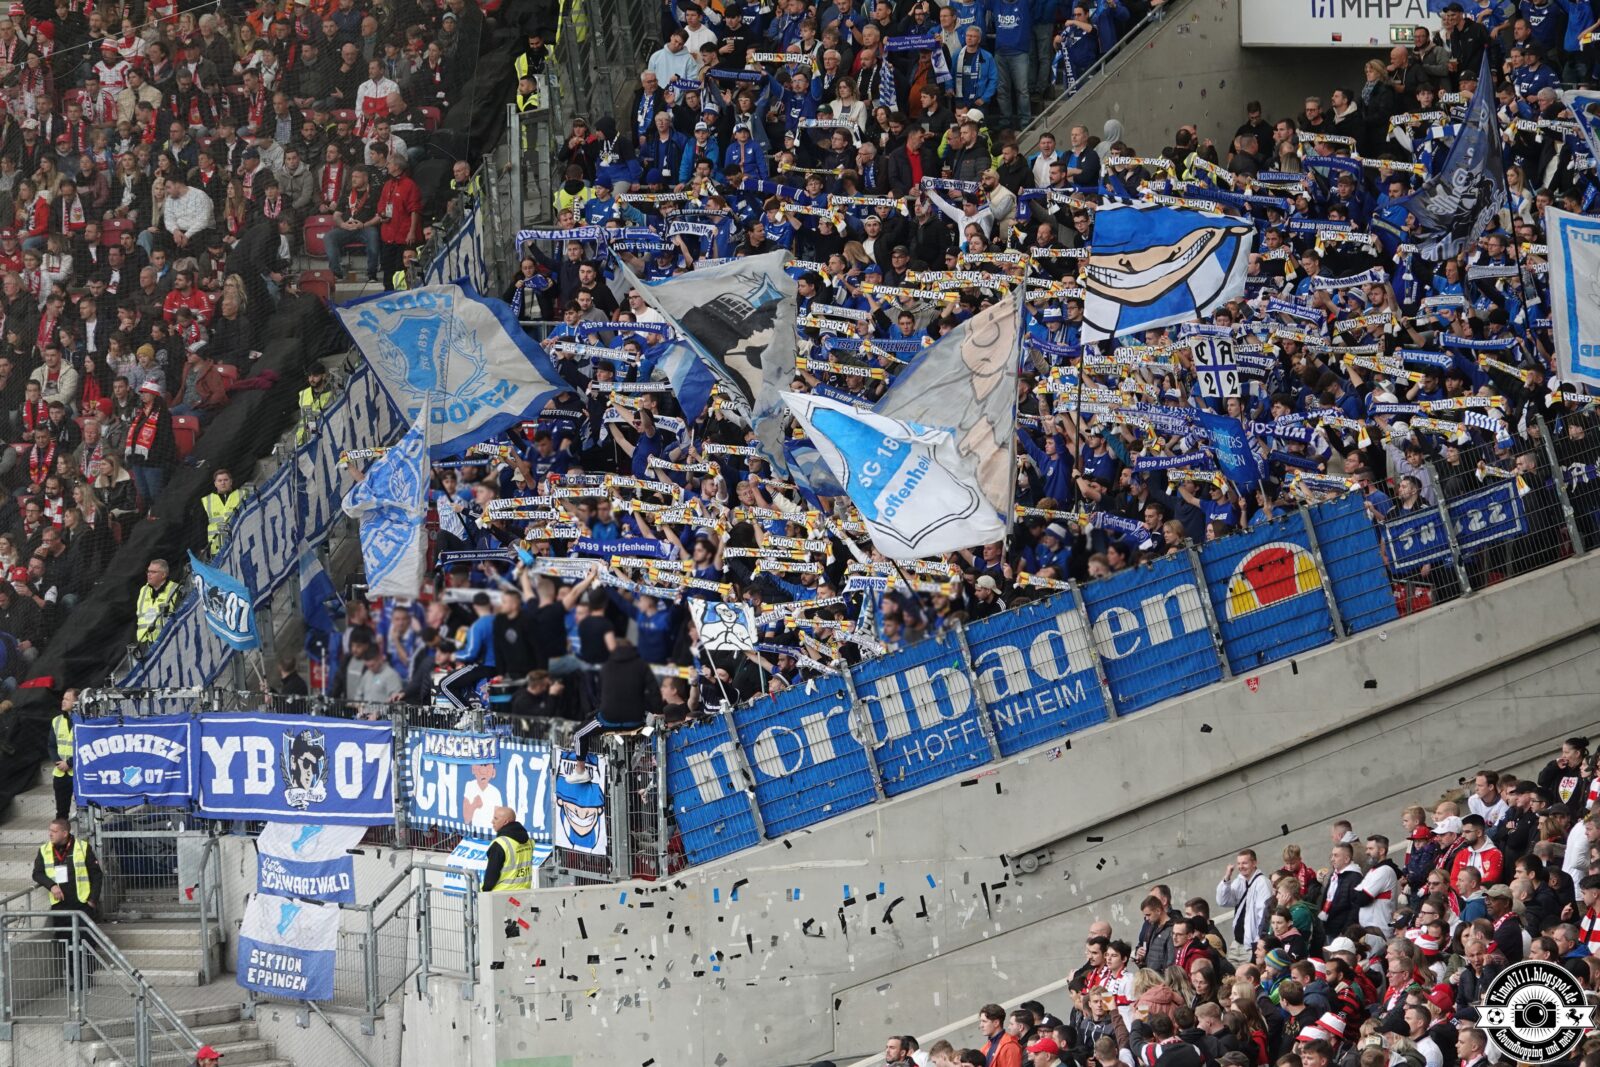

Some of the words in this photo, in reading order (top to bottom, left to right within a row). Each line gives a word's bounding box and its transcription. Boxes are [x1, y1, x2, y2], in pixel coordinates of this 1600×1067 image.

[752, 52, 775, 62] NORD
[786, 54, 813, 65] BADEN
[620, 192, 645, 202] NORD
[655, 192, 688, 202] BADEN
[1152, 194, 1175, 205] NORD
[1188, 199, 1217, 211] BADEN
[1321, 230, 1338, 242] ORD
[613, 241, 675, 252] HOFFENHEIM
[872, 285, 899, 295] NORD
[913, 287, 945, 300] BADEN
[582, 321, 603, 331] 1899
[606, 320, 662, 332] Hoffenheim
[586, 346, 629, 361] HOFFENHEIM
[806, 360, 831, 372] NORD
[842, 366, 871, 378] BADEN
[1353, 357, 1376, 371] NORD
[1384, 366, 1410, 379] BADEN
[1430, 398, 1455, 411] NORD
[1465, 396, 1491, 407] BADEN
[1563, 392, 1592, 403] NORD
[1138, 459, 1157, 469] 1899
[882, 454, 934, 524] offenhei
[488, 510, 514, 521] NORD
[528, 511, 560, 522] BADEN
[554, 528, 582, 540] BADEN
[602, 541, 655, 553] Hoffenheim
[620, 557, 644, 568] NORD
[655, 559, 684, 571] BADEN
[759, 560, 780, 571] NORD
[791, 562, 818, 573] BADEN
[686, 583, 1209, 804] nordbaden
[78, 733, 186, 767] ROOKIEZ
[425, 733, 497, 759] NASCENTI
[202, 735, 276, 795] YB
[334, 741, 392, 800] 07
[98, 770, 121, 785] YB
[144, 770, 164, 783] 07
[261, 866, 350, 895] SCHWARZWALD
[250, 948, 303, 973] SEKTION
[247, 967, 308, 992] EPPINGEN
